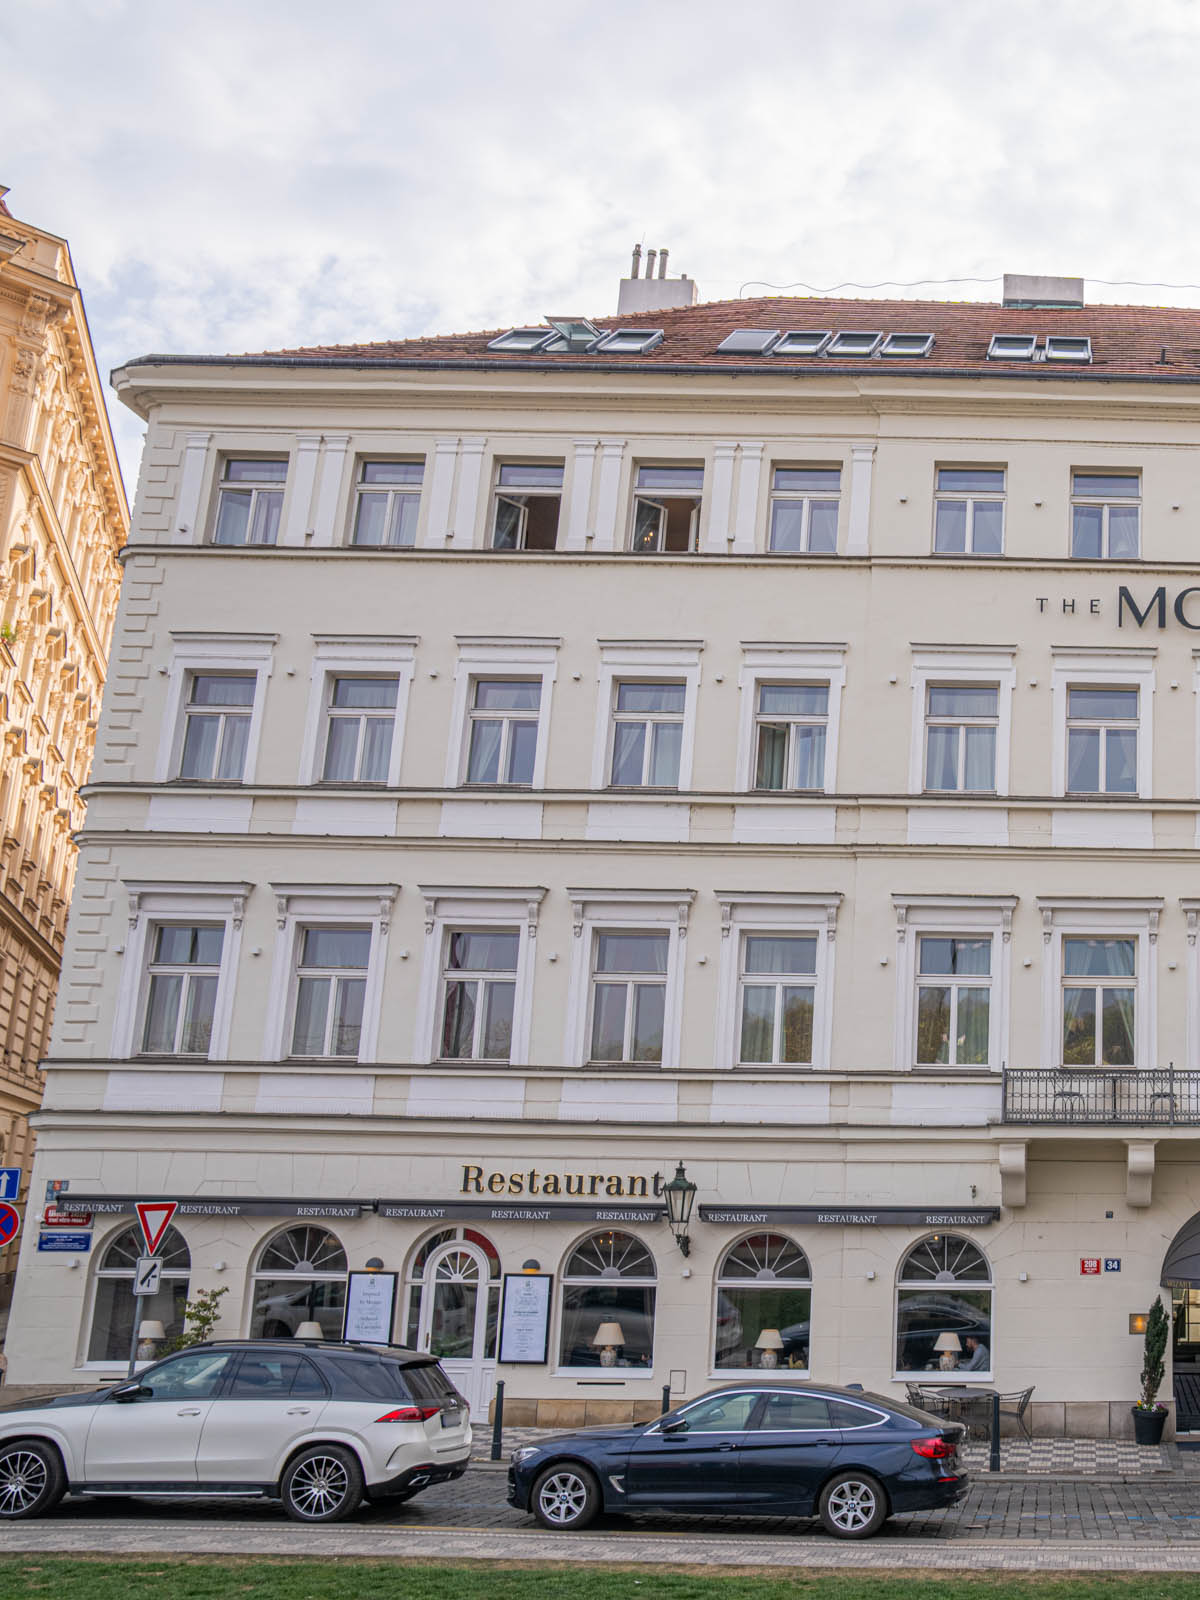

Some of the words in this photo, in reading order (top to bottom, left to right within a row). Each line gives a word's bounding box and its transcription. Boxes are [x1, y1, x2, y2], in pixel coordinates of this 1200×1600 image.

[1036, 598, 1100, 614] THE
[460, 1165, 664, 1197] Restaurant
[63, 1203, 124, 1213] RESTAURANT
[180, 1205, 240, 1215] RESTAURANT
[297, 1207, 356, 1217] RESTAURANT
[385, 1208, 445, 1218] RESTAURANT
[491, 1210, 551, 1219] RESTAURANT
[597, 1211, 656, 1220] RESTAURANT
[708, 1213, 768, 1223] RESTAURANT
[818, 1214, 877, 1224] RESTAURANT
[925, 1215, 985, 1225] RESTAURANT
[1106, 1260, 1119, 1270] 34
